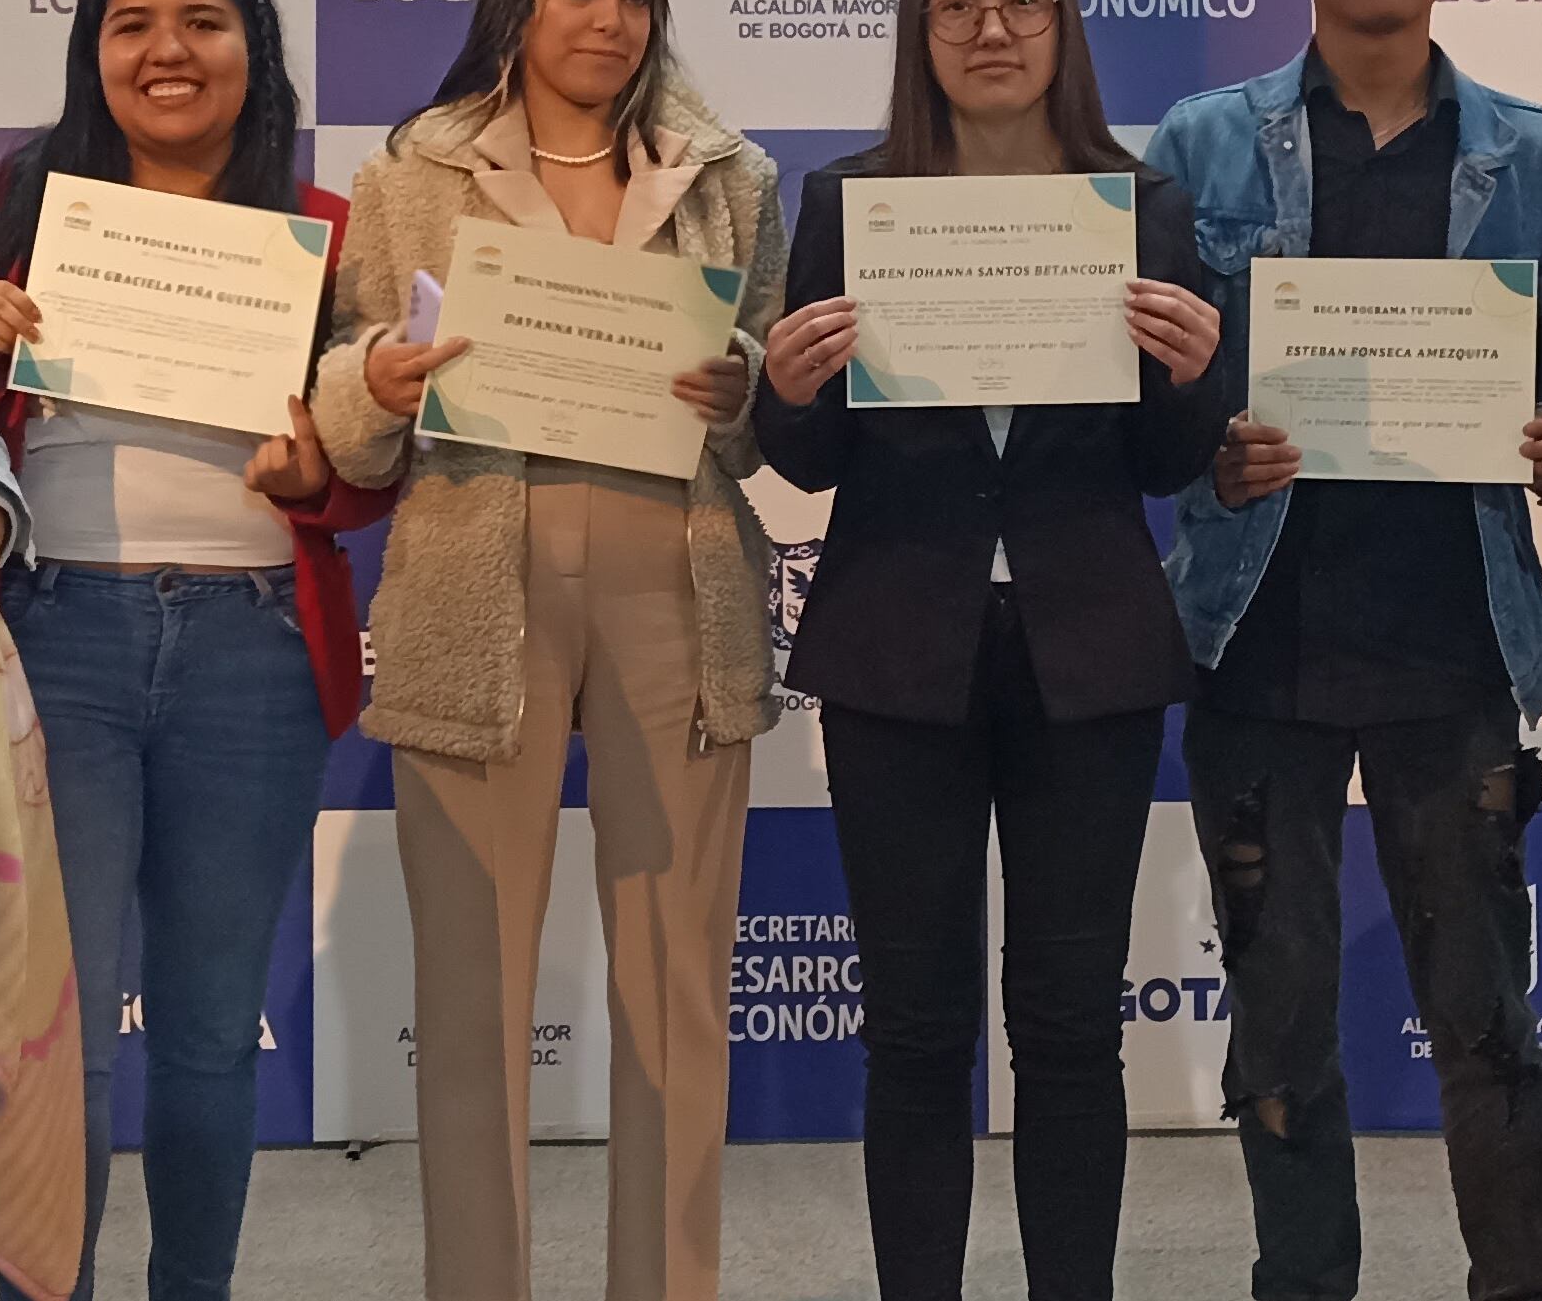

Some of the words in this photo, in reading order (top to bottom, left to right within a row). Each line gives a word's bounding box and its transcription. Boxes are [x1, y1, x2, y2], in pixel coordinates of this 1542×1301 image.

[832, 0, 897, 17] MAYOR
[739, 23, 764, 39] DE
[769, 19, 851, 39] BOGOTÁ
[909, 224, 938, 236] BECA
[941, 223, 1006, 236] PROGRAMA
[1009, 223, 1024, 234] TU
[56, 262, 101, 280] ANGIE
[104, 270, 173, 293] GRACIELA
[859, 266, 906, 280] KAREN
[909, 266, 973, 280] JOHANNA
[977, 264, 1030, 278] SANTOS
[1034, 262, 1125, 278] BETANCOURT
[1313, 305, 1342, 316] BECA
[1345, 305, 1408, 316] PROGRAMA
[1285, 345, 1347, 359] ESTEBAN
[1350, 345, 1412, 359] FONSECA
[1416, 347, 1500, 362] AMEZQUITA
